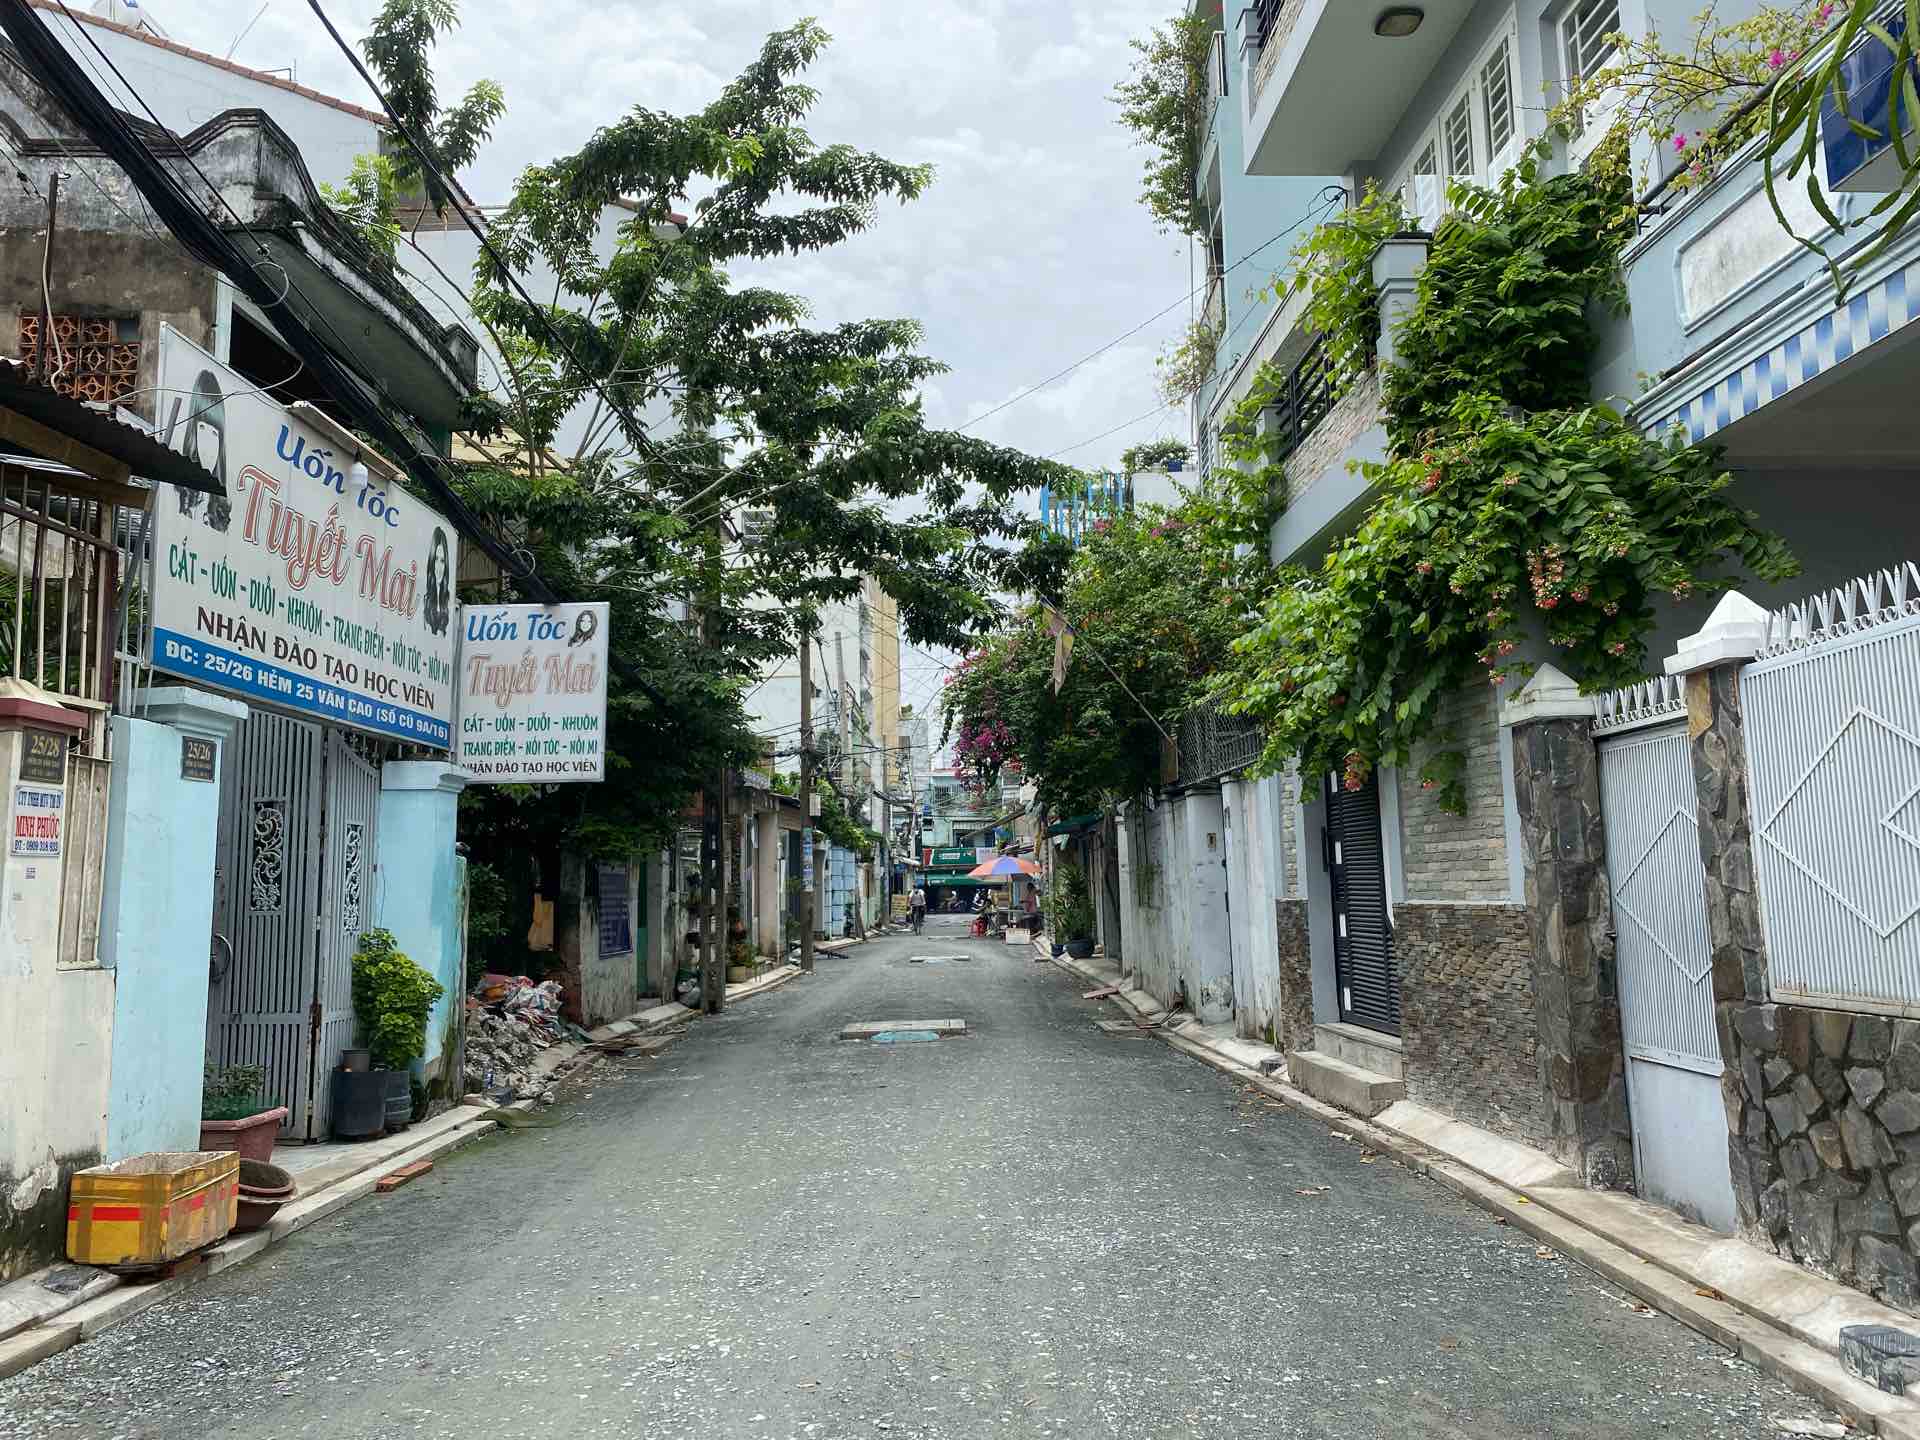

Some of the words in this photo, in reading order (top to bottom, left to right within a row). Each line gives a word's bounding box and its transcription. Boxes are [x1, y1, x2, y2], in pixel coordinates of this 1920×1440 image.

[276, 424, 344, 494] Uốn
[237, 464, 349, 591] Tuyết
[355, 534, 417, 618] Mai
[333, 615, 363, 653] TRANG
[467, 611, 518, 642] Uốn
[527, 613, 567, 641] Tóc
[197, 605, 266, 654] NHẬN
[273, 635, 317, 670] ĐÀO
[322, 653, 358, 685] TẠO
[364, 668, 398, 699] HỌC
[402, 681, 435, 711] VIÊN
[469, 646, 540, 709] Tuyết
[543, 652, 597, 695] Mai
[166, 639, 199, 665] ĐC:
[204, 652, 253, 682] 25/26
[296, 682, 314, 701] 25
[317, 687, 346, 712] VĂN
[348, 698, 373, 719] CAO
[376, 706, 397, 725] (SỐ
[399, 713, 414, 730] CŨ
[416, 719, 449, 741] 9A/16)
[463, 741, 492, 757] TRANG
[495, 758, 519, 774] ĐÀO
[520, 762, 543, 776] TẠO
[545, 761, 569, 775] HỌC
[573, 758, 597, 773] VIÊN
[16, 815, 35, 837] MINH
